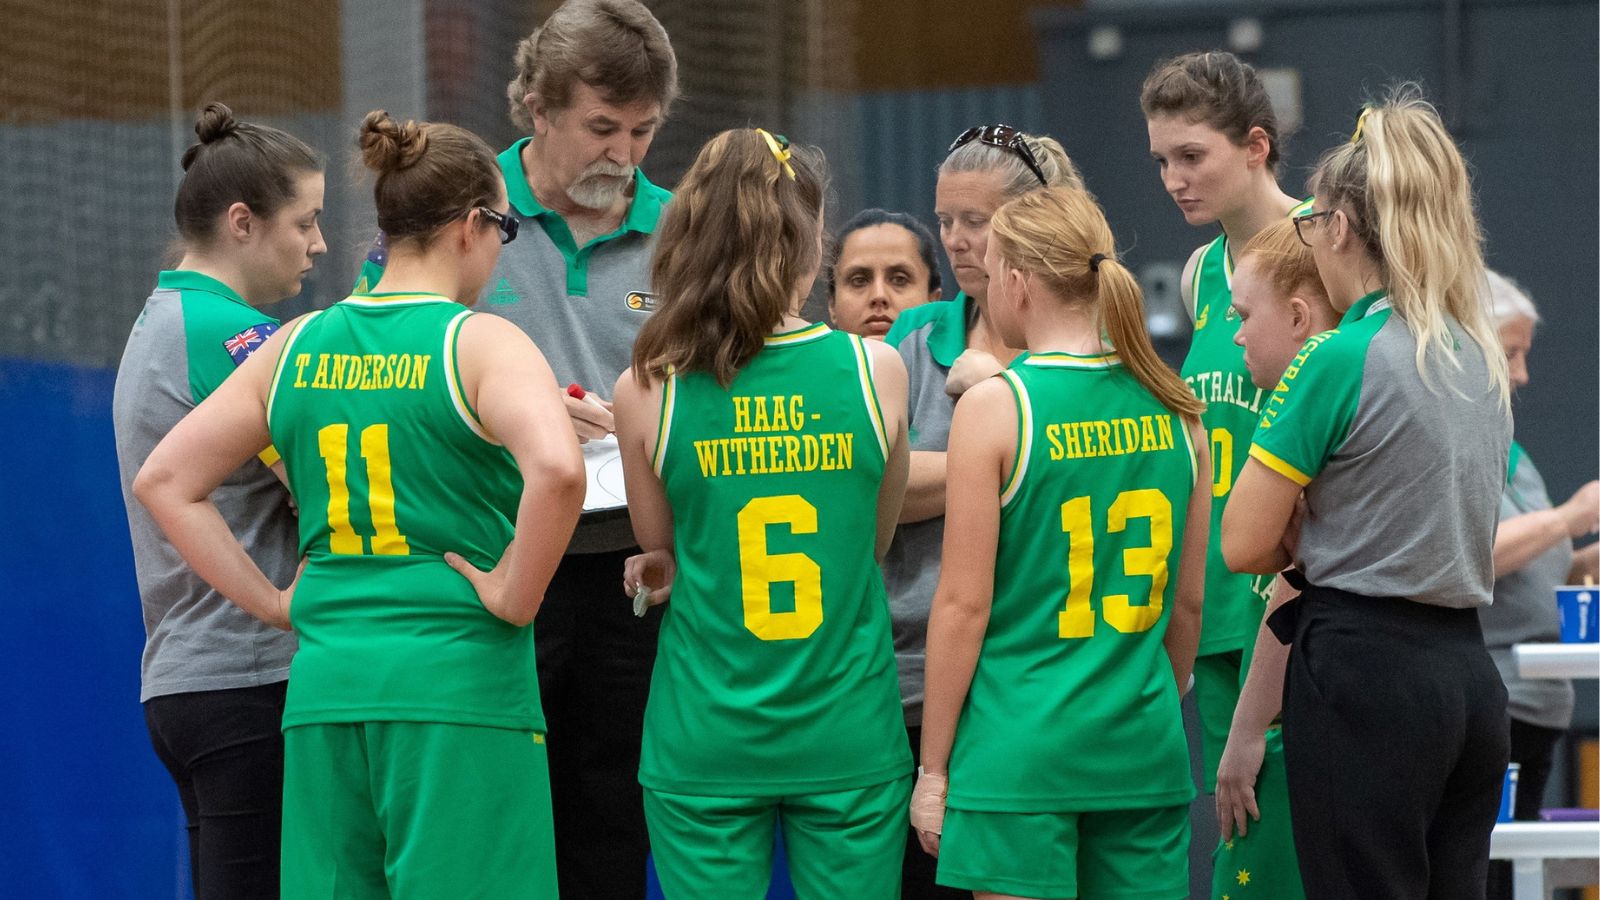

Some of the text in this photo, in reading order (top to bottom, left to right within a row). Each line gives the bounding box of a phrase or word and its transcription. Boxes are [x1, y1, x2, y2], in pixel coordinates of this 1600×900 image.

[294, 353, 431, 390] T. ANDERSON
[694, 433, 854, 477] WITHERDEN
[1046, 414, 1175, 460] SHERIDAN
[318, 423, 410, 556] 11
[737, 494, 824, 641] 6
[1058, 488, 1173, 639] 13
